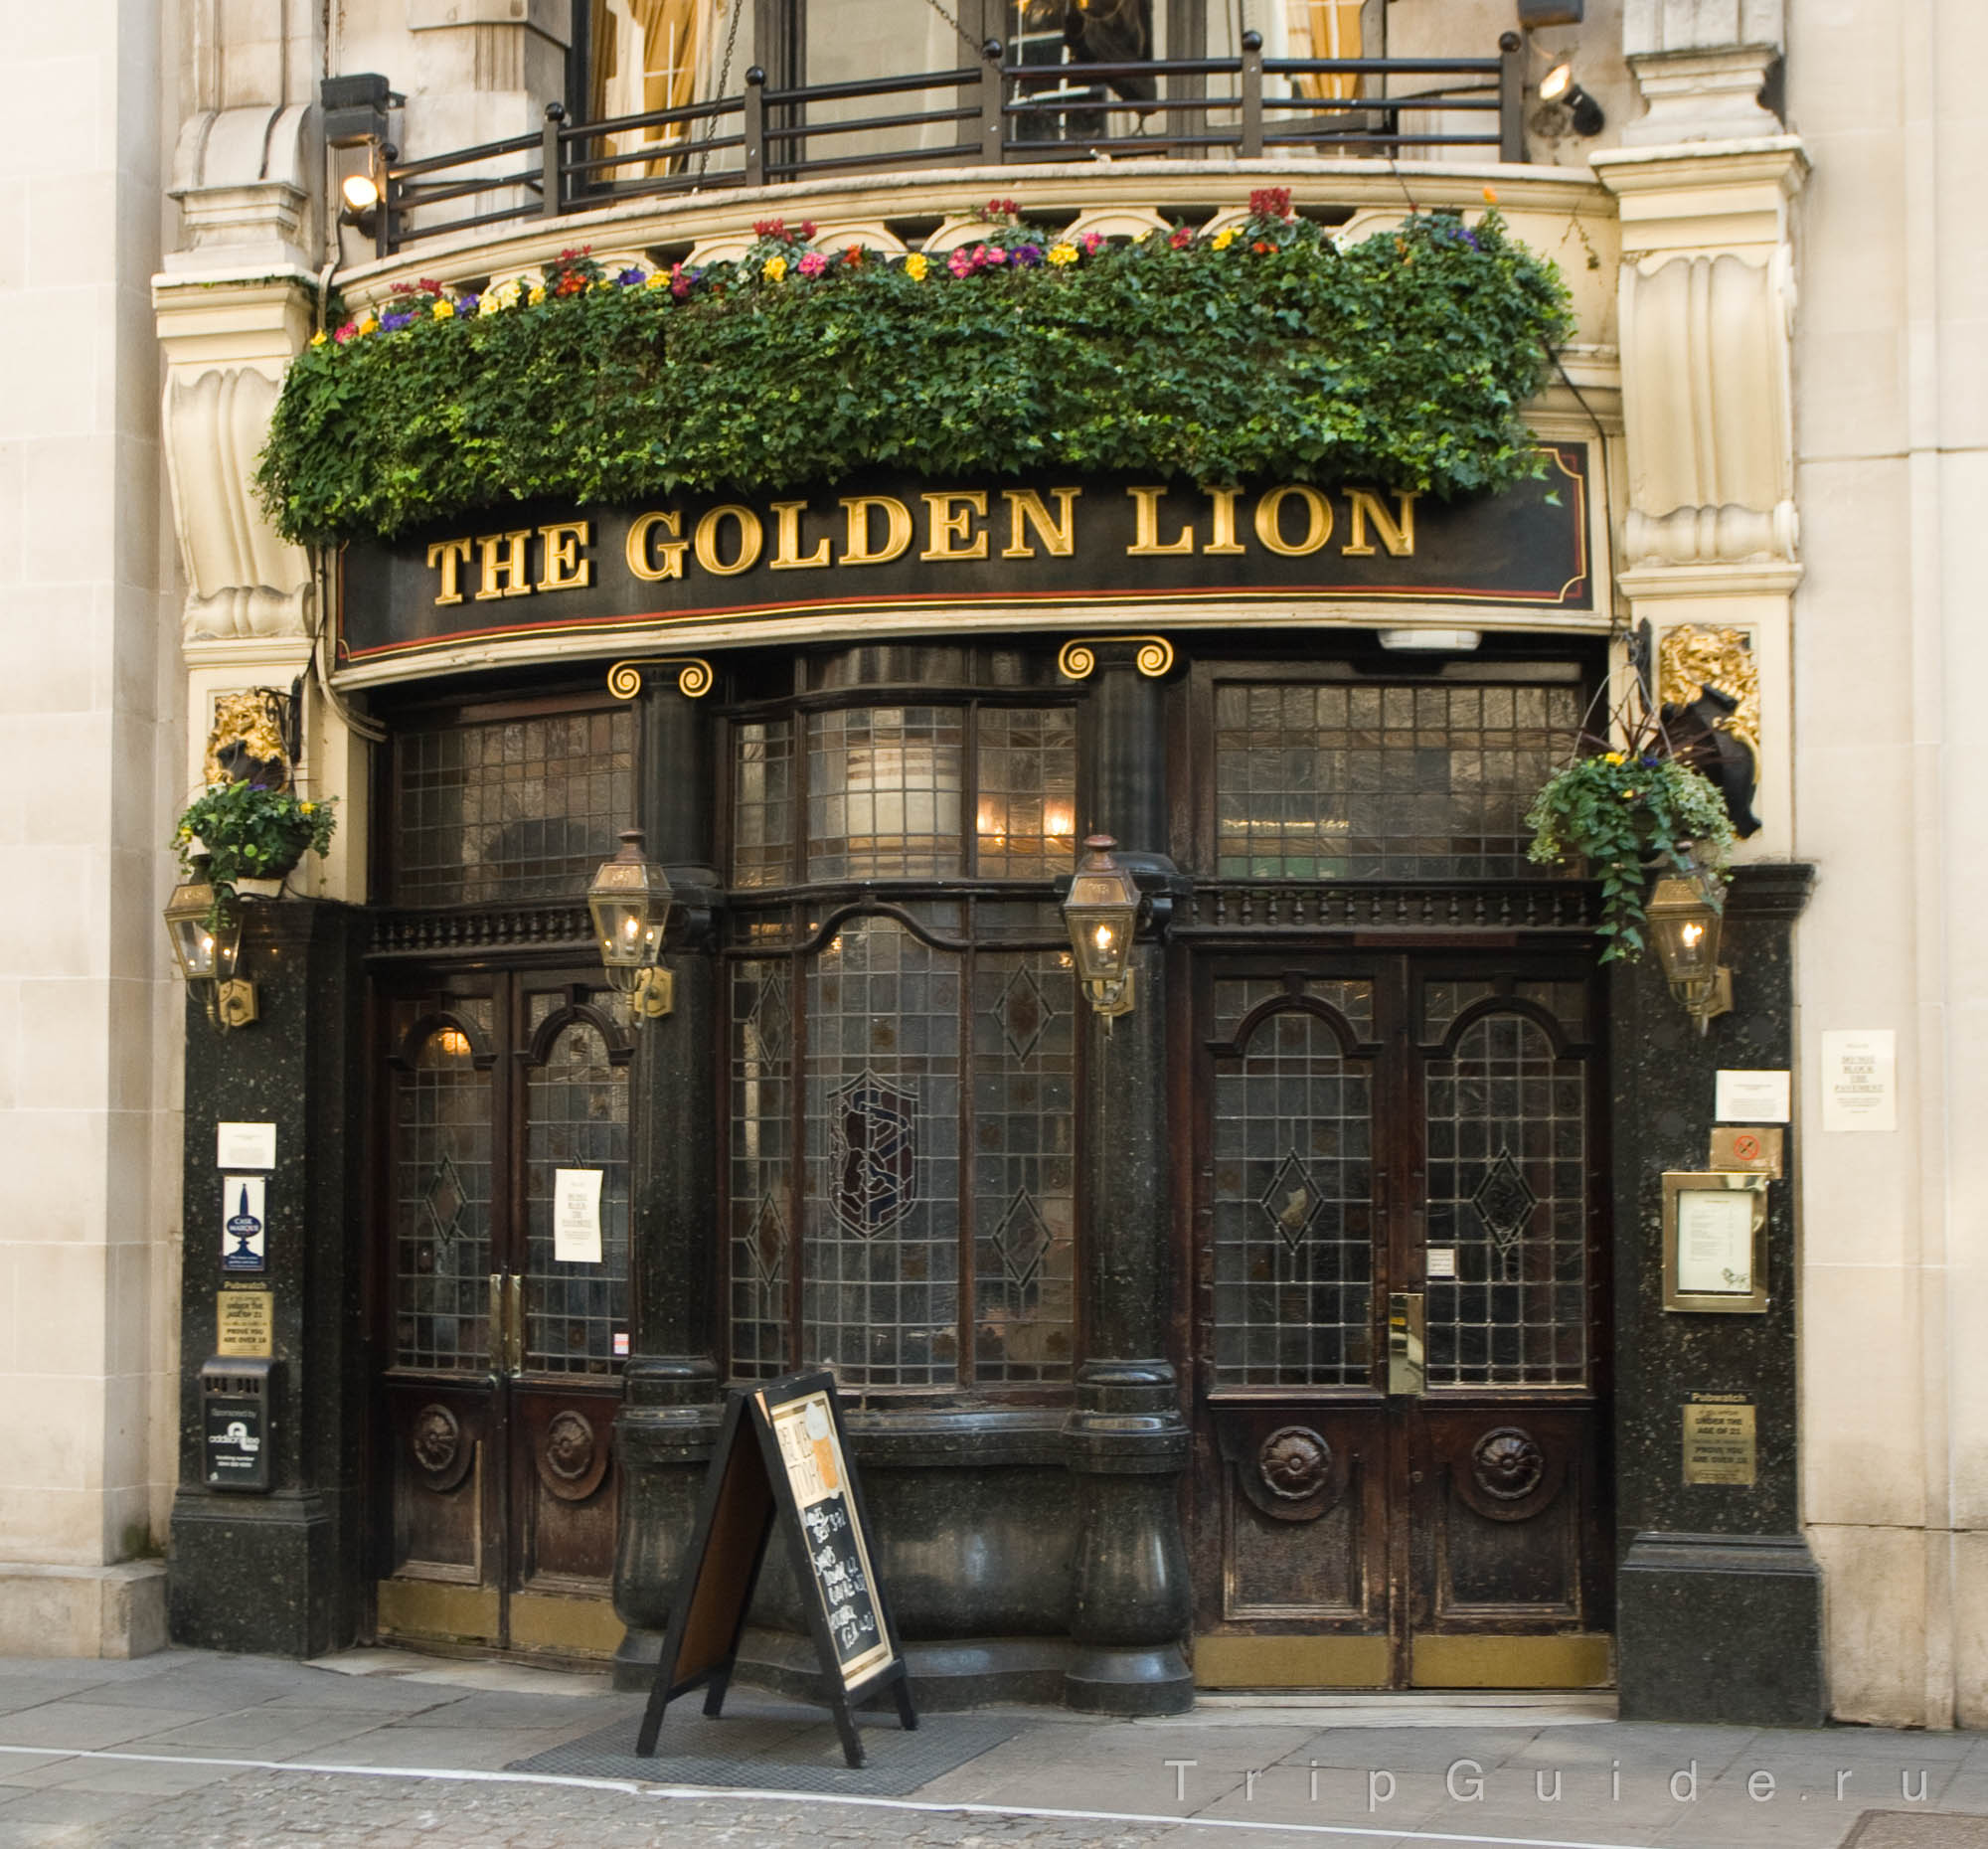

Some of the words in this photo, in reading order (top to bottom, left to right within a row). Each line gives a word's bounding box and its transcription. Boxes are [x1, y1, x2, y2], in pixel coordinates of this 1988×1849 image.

[427, 521, 589, 605] THE
[625, 486, 1081, 582] GOLDEN
[1126, 483, 1422, 557] LION
